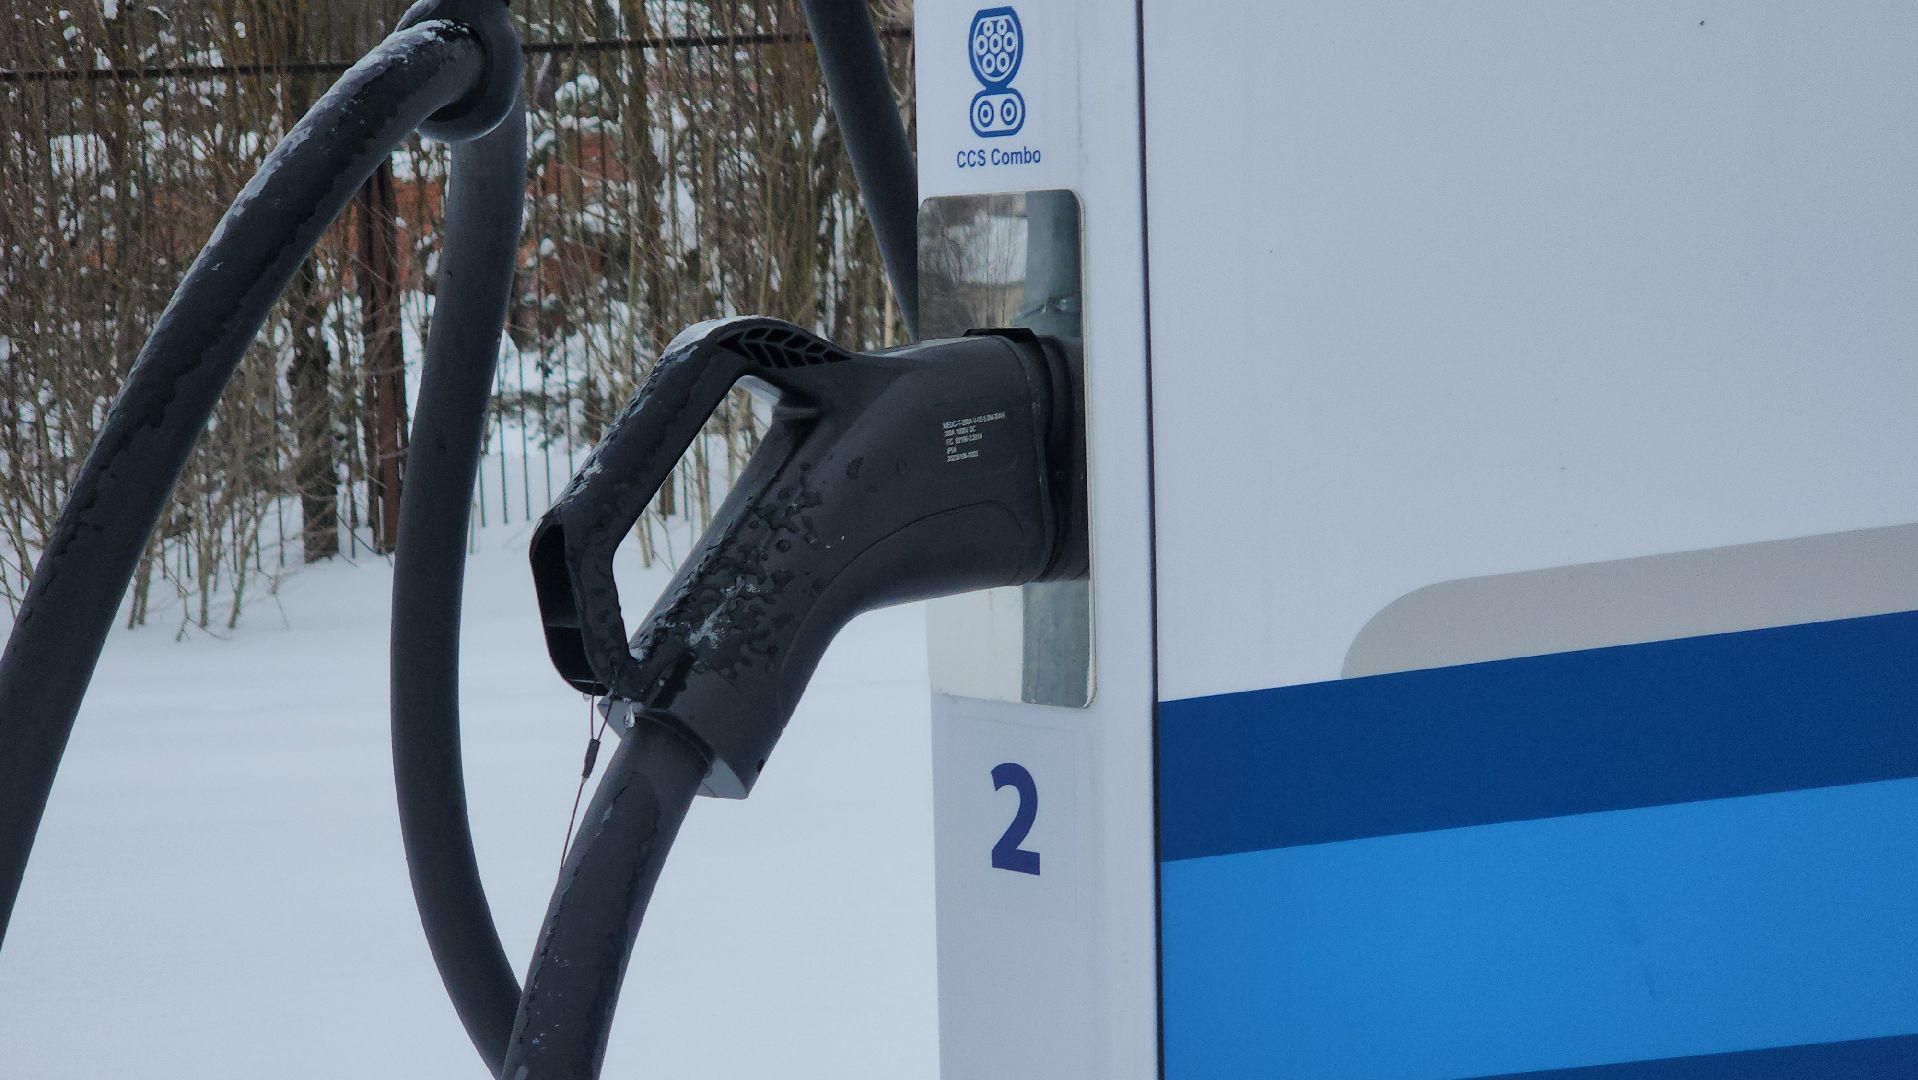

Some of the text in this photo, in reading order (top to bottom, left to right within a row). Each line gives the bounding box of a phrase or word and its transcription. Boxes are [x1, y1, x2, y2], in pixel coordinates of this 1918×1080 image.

[957, 146, 1041, 168] CCS Combo
[991, 762, 1041, 876] 2
